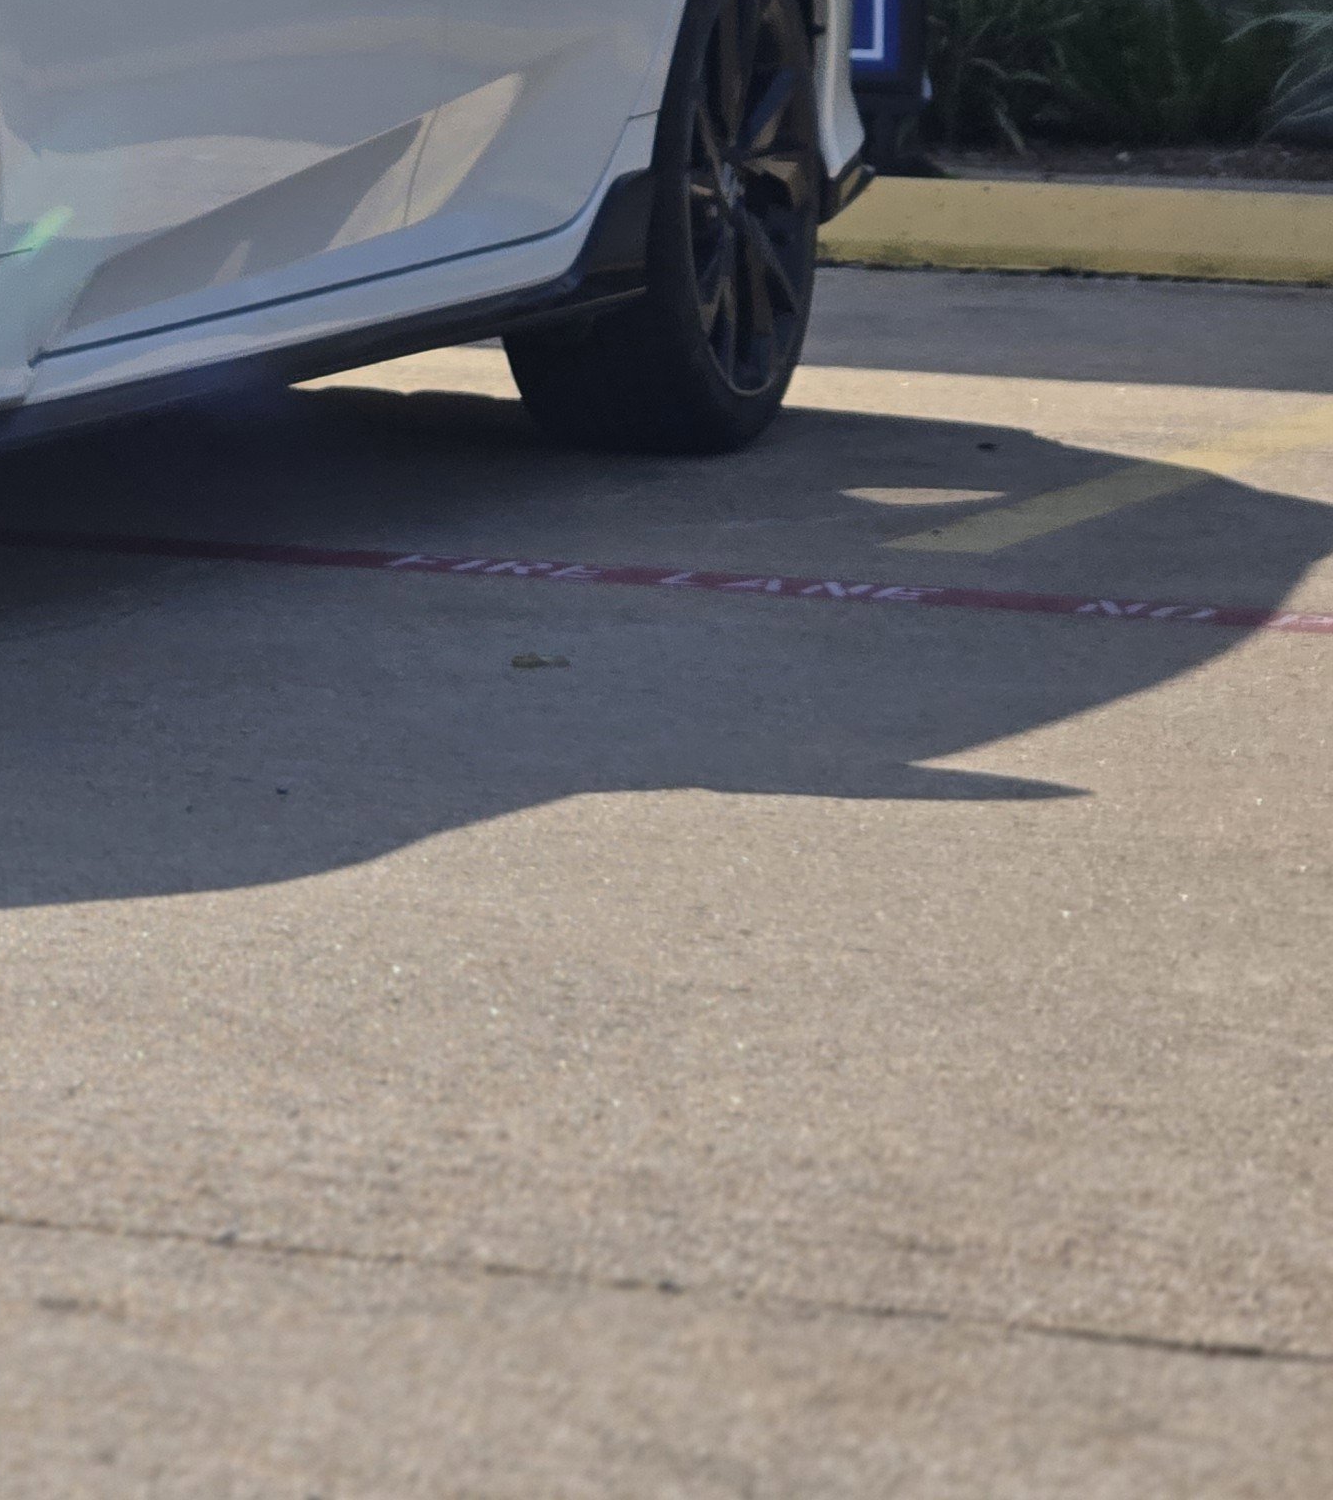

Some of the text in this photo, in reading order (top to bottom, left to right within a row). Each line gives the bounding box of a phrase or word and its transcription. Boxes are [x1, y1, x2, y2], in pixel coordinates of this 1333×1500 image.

[386, 554, 602, 580] FIRE
[658, 570, 945, 601] LANE
[1076, 599, 1216, 619] NO
